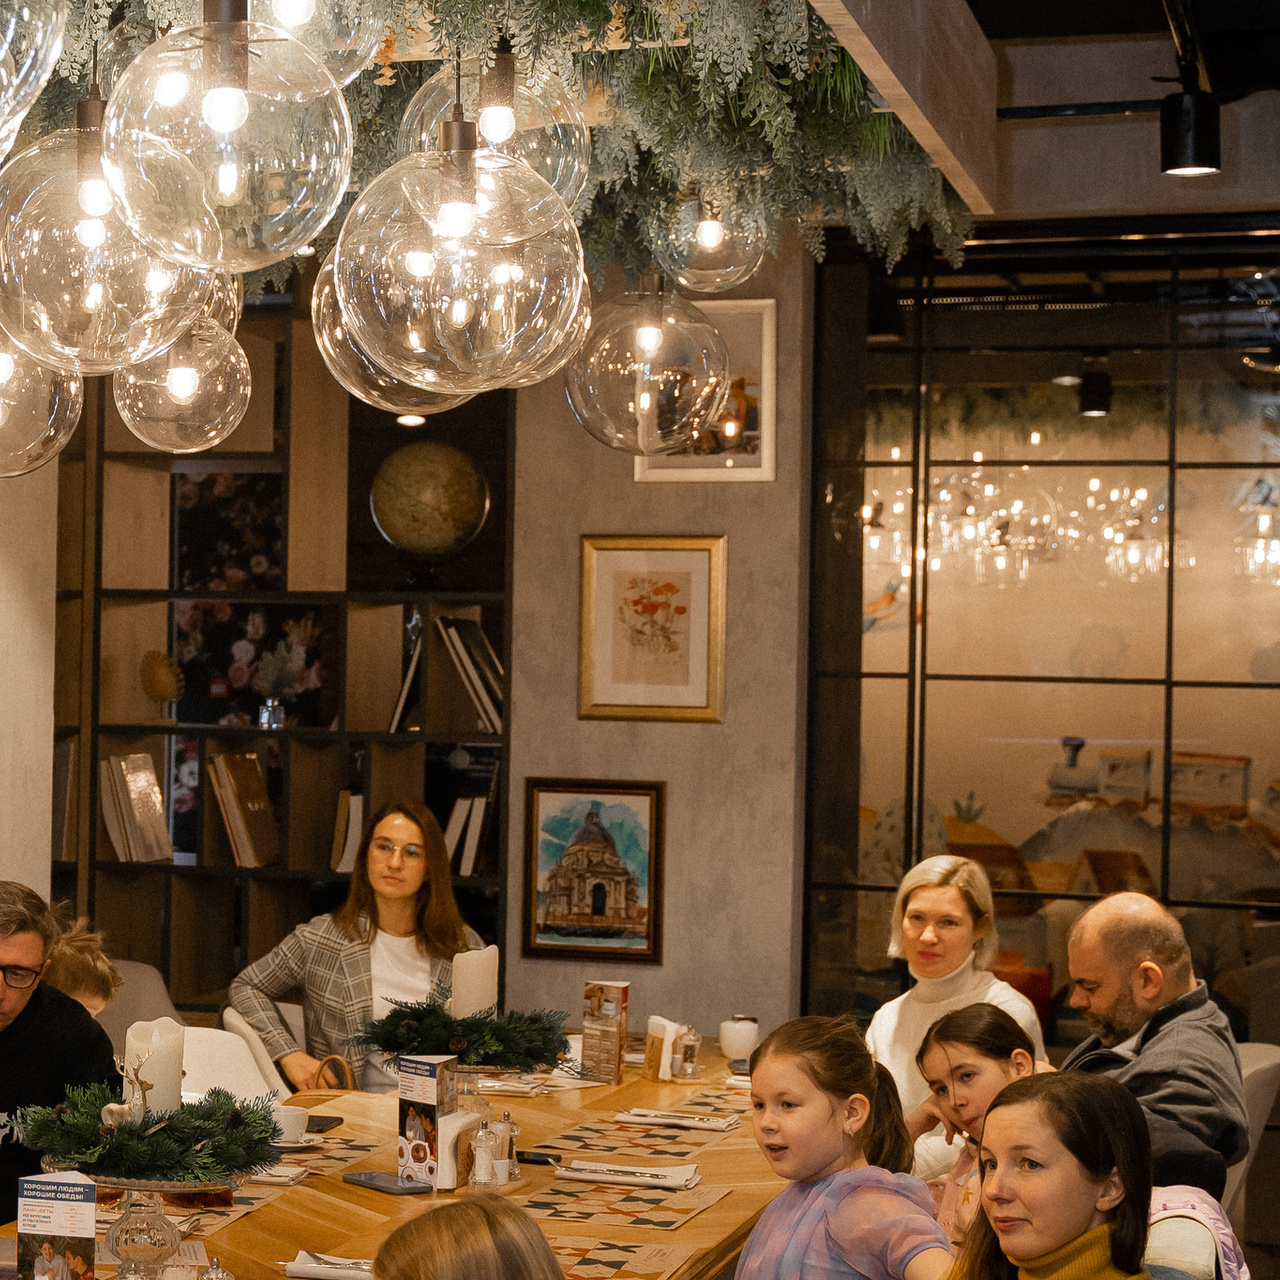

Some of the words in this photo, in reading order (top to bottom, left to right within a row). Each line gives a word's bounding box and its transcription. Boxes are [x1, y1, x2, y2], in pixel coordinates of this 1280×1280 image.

[23, 1183, 57, 1191] ХОРОШИМ
[57, 1185, 84, 1193] ЛЮДЯМ
[23, 1190, 56, 1198] ХОРОШИЕ
[56, 1192, 84, 1200] ОБЕДЫ!
